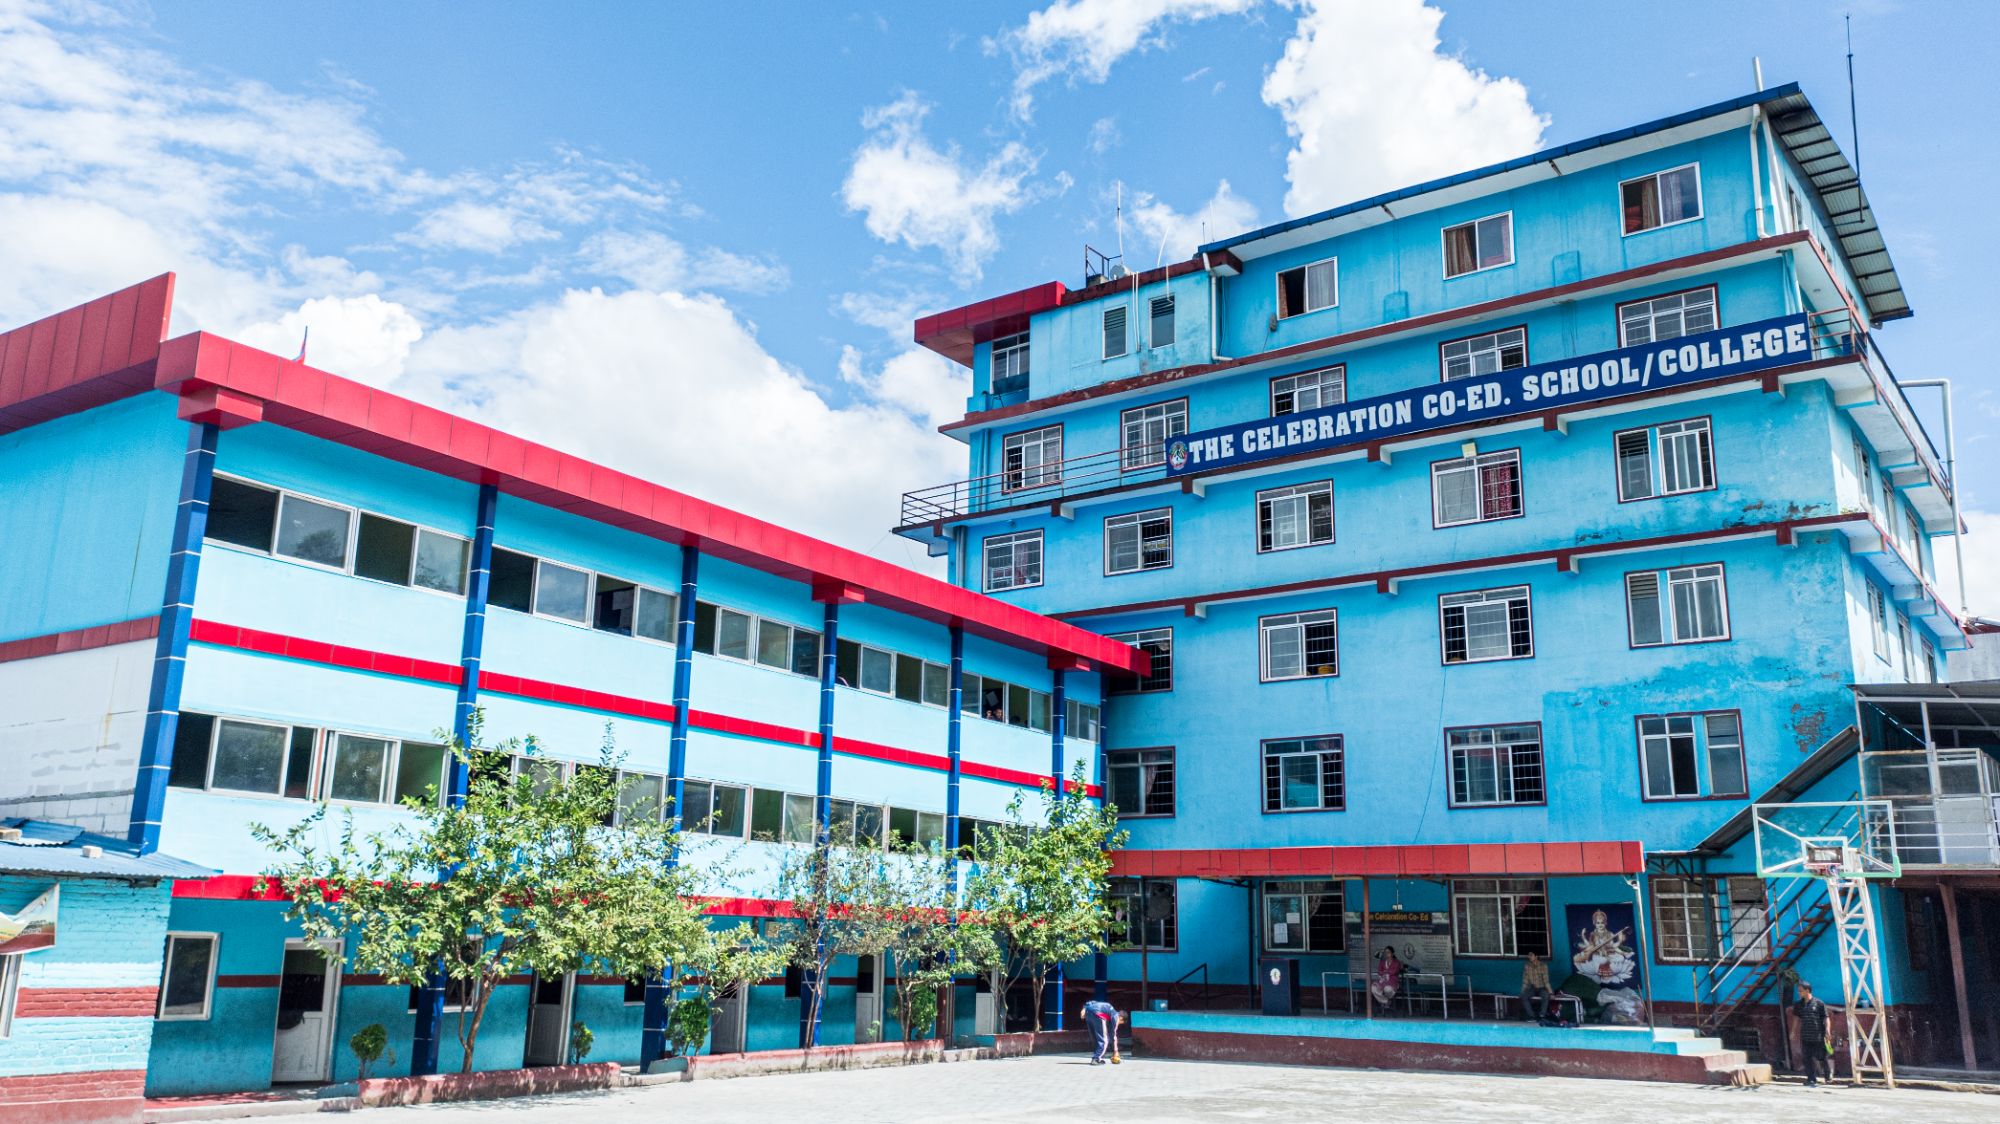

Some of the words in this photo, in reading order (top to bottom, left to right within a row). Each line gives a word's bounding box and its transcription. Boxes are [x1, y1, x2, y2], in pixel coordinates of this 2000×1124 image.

[1189, 434, 1234, 464] THE
[1242, 399, 1412, 454] CELEBRATION
[1422, 382, 1511, 420] CO-ED.
[1522, 323, 1808, 402] SCHOOL/COLLEGE
